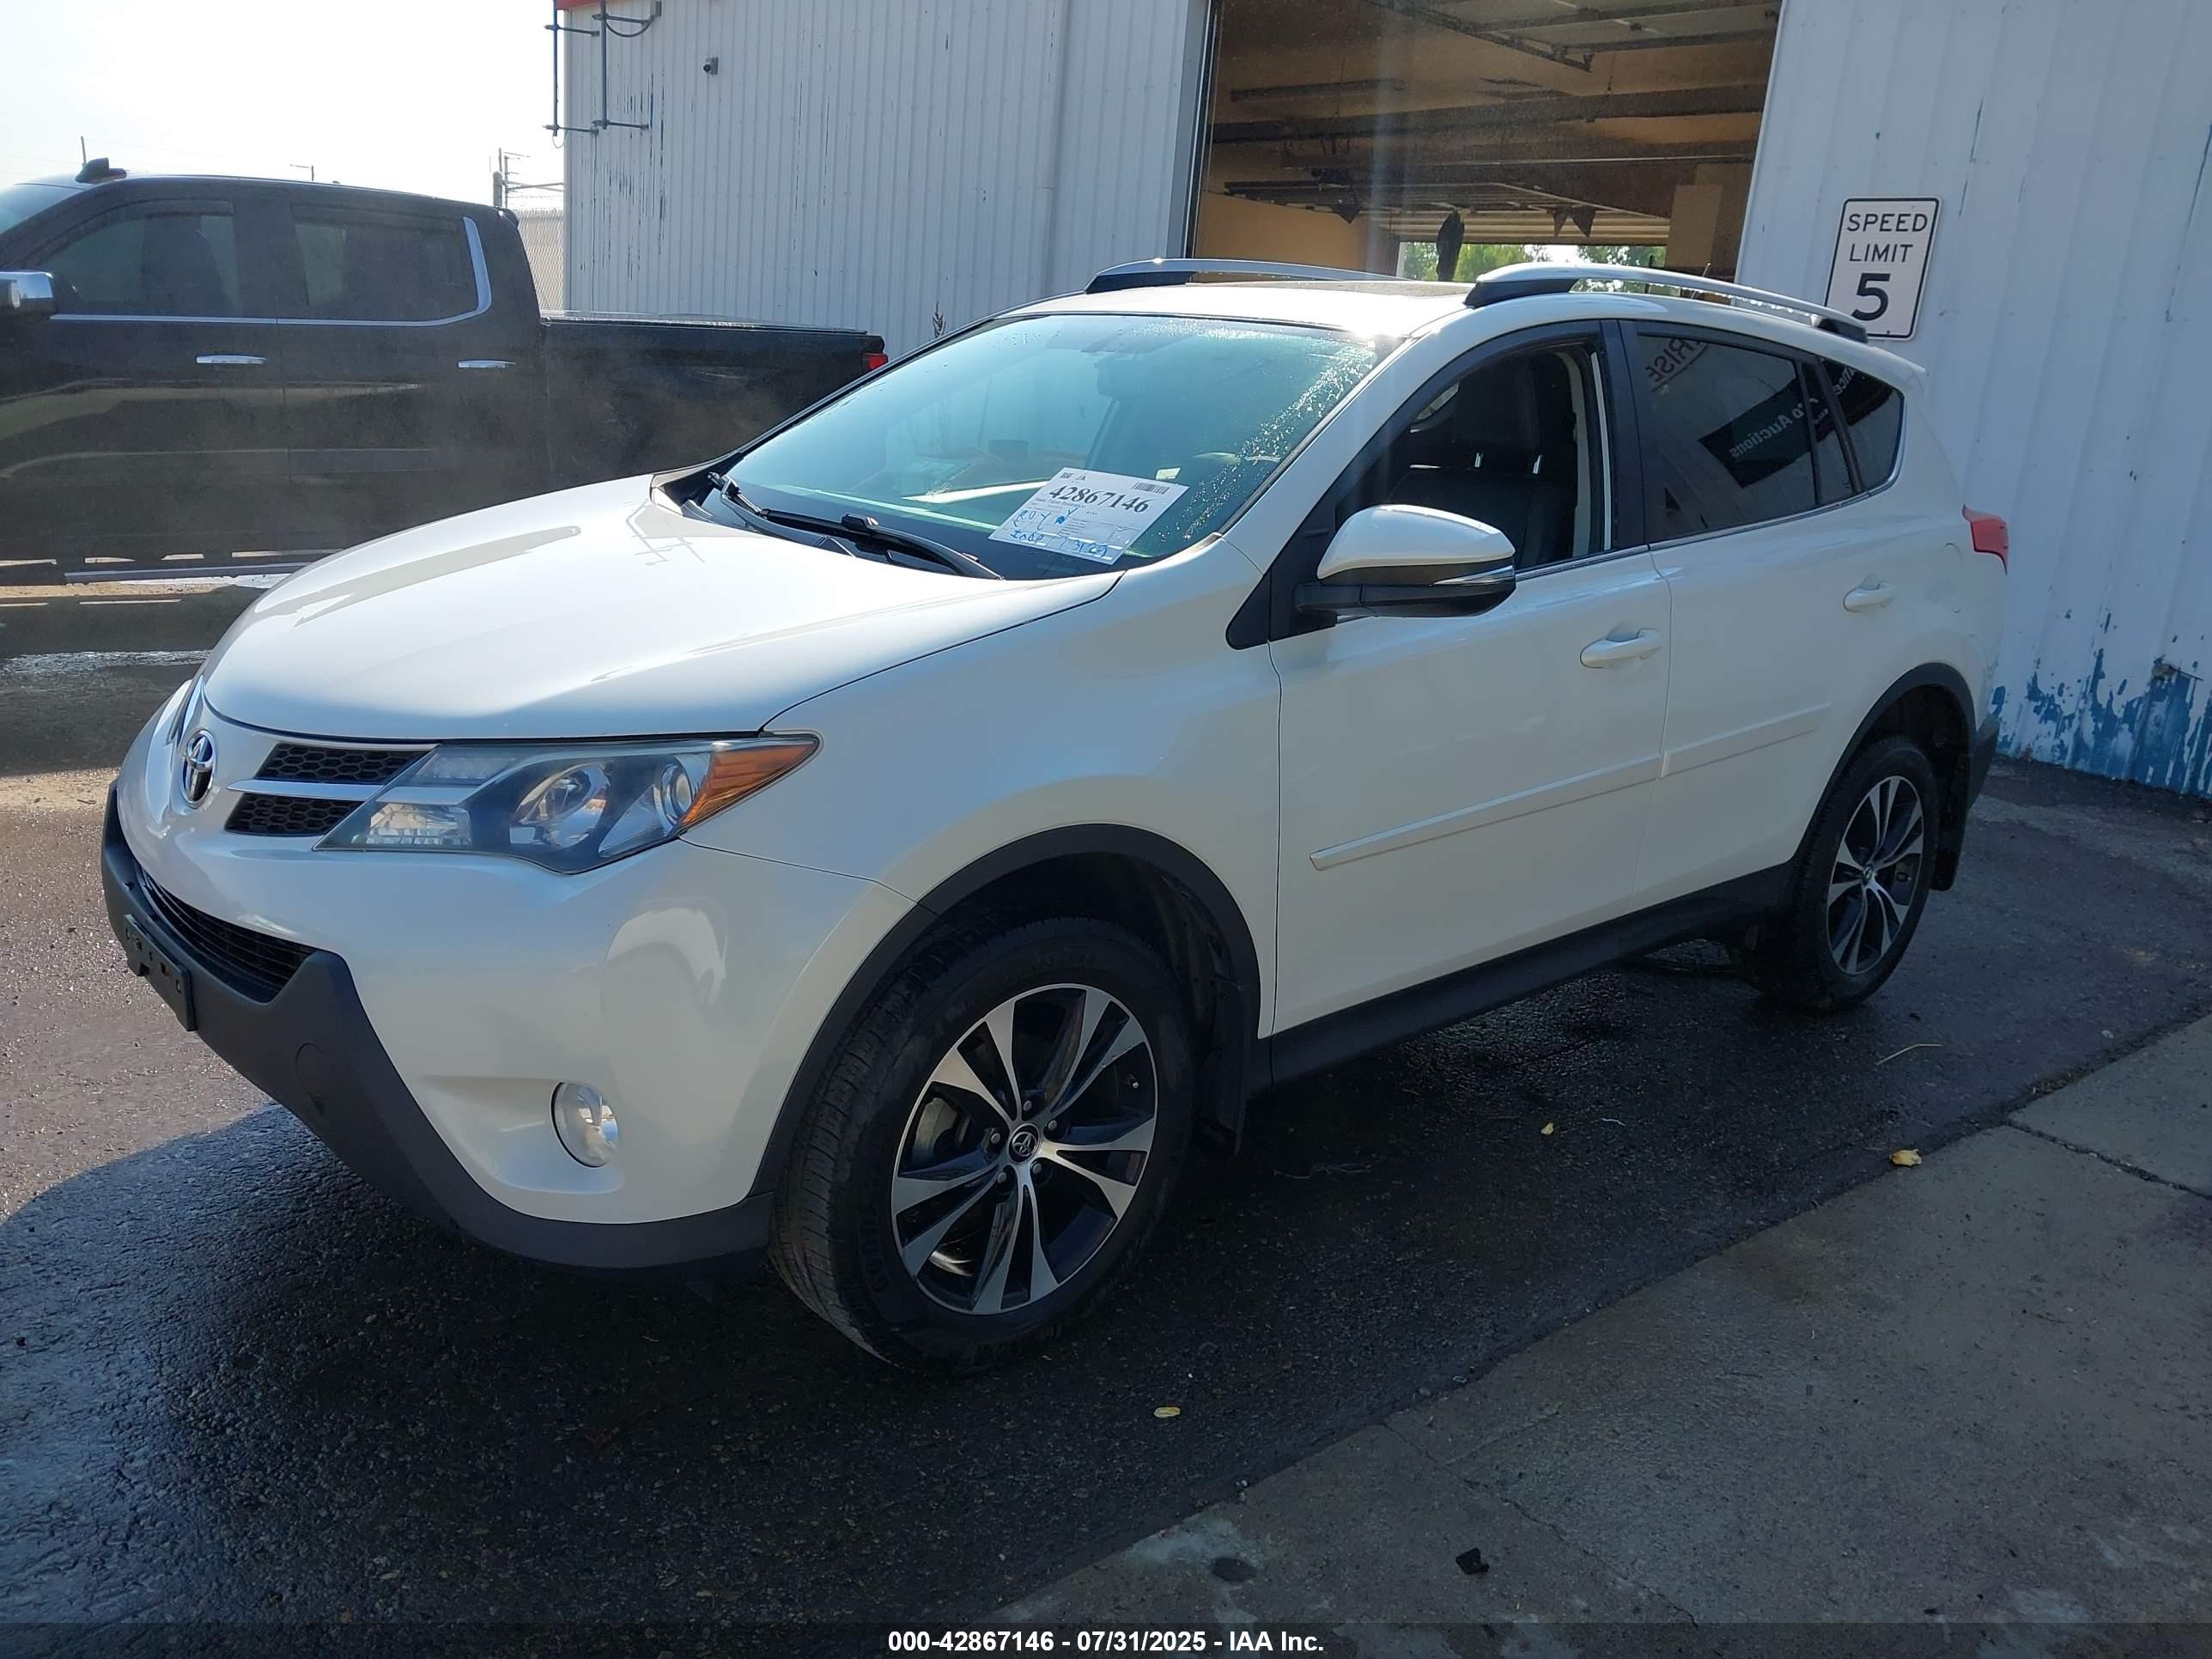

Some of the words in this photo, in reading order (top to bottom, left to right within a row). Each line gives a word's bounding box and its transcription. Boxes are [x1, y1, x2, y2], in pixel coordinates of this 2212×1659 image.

[1846, 213, 1929, 233] SPEED
[1849, 243, 1914, 263] LIMIT
[1850, 272, 1892, 321] 5
[1048, 485, 1155, 513] 42867146
